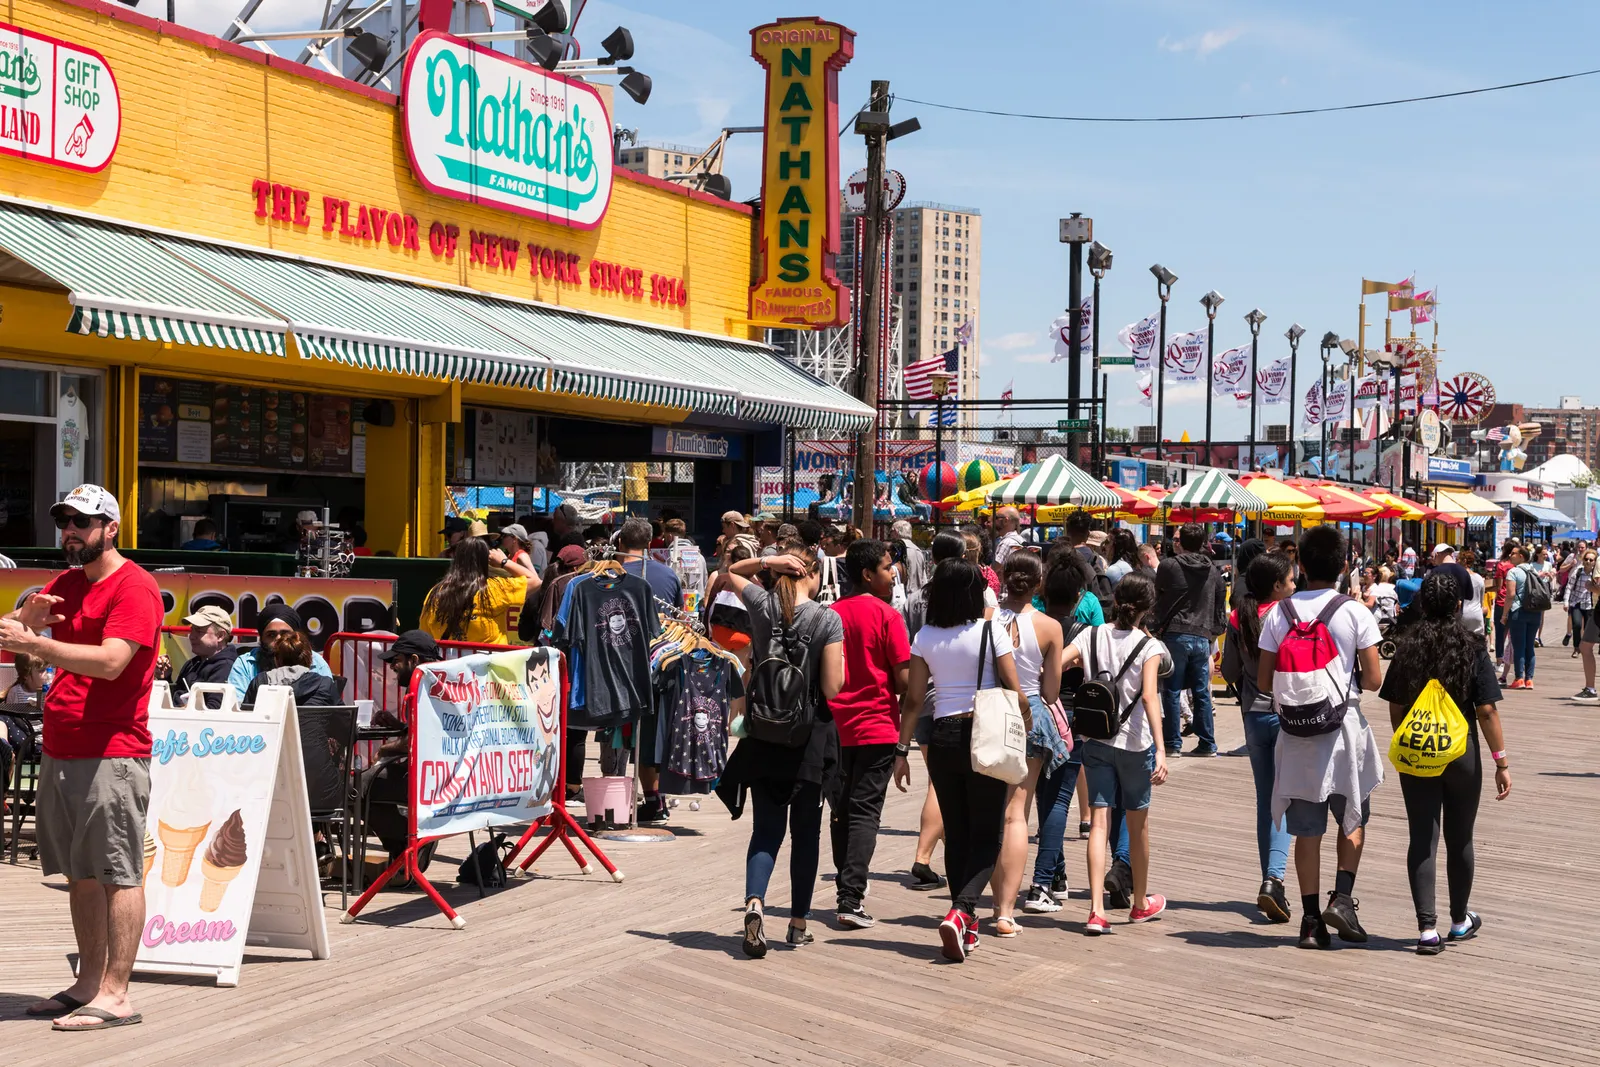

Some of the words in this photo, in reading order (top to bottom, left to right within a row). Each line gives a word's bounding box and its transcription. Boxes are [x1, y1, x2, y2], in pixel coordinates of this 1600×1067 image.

[760, 29, 834, 44] ORIGINAL
[64, 58, 100, 88] GIFT
[64, 85, 100, 111] SHOP
[530, 88, 550, 106] Since
[551, 95, 565, 112] 1916
[1, 105, 40, 145] LAND
[426, 49, 593, 182] Nathan's
[777, 47, 814, 283] NATHANS
[489, 174, 545, 199] FAMOUS
[252, 179, 310, 228] THE
[322, 196, 420, 251] FLAVOR
[429, 221, 460, 258] OF
[469, 229, 520, 271] NEW
[527, 243, 582, 285] YORK
[589, 258, 644, 297] SINCE
[650, 273, 687, 307] 1916
[755, 297, 832, 316] FRANKFURTERS
[765, 287, 823, 298] FAMOUS
[429, 669, 480, 713] Ruby's
[1288, 714, 1326, 726] HILFIGER
[1406, 720, 1448, 734] YOUTH
[152, 729, 190, 765] oft
[192, 728, 267, 758] Serve
[1399, 732, 1452, 752] LEAD
[480, 751, 503, 796] AND
[508, 750, 534, 793] SEE!
[142, 915, 237, 948] Cream
